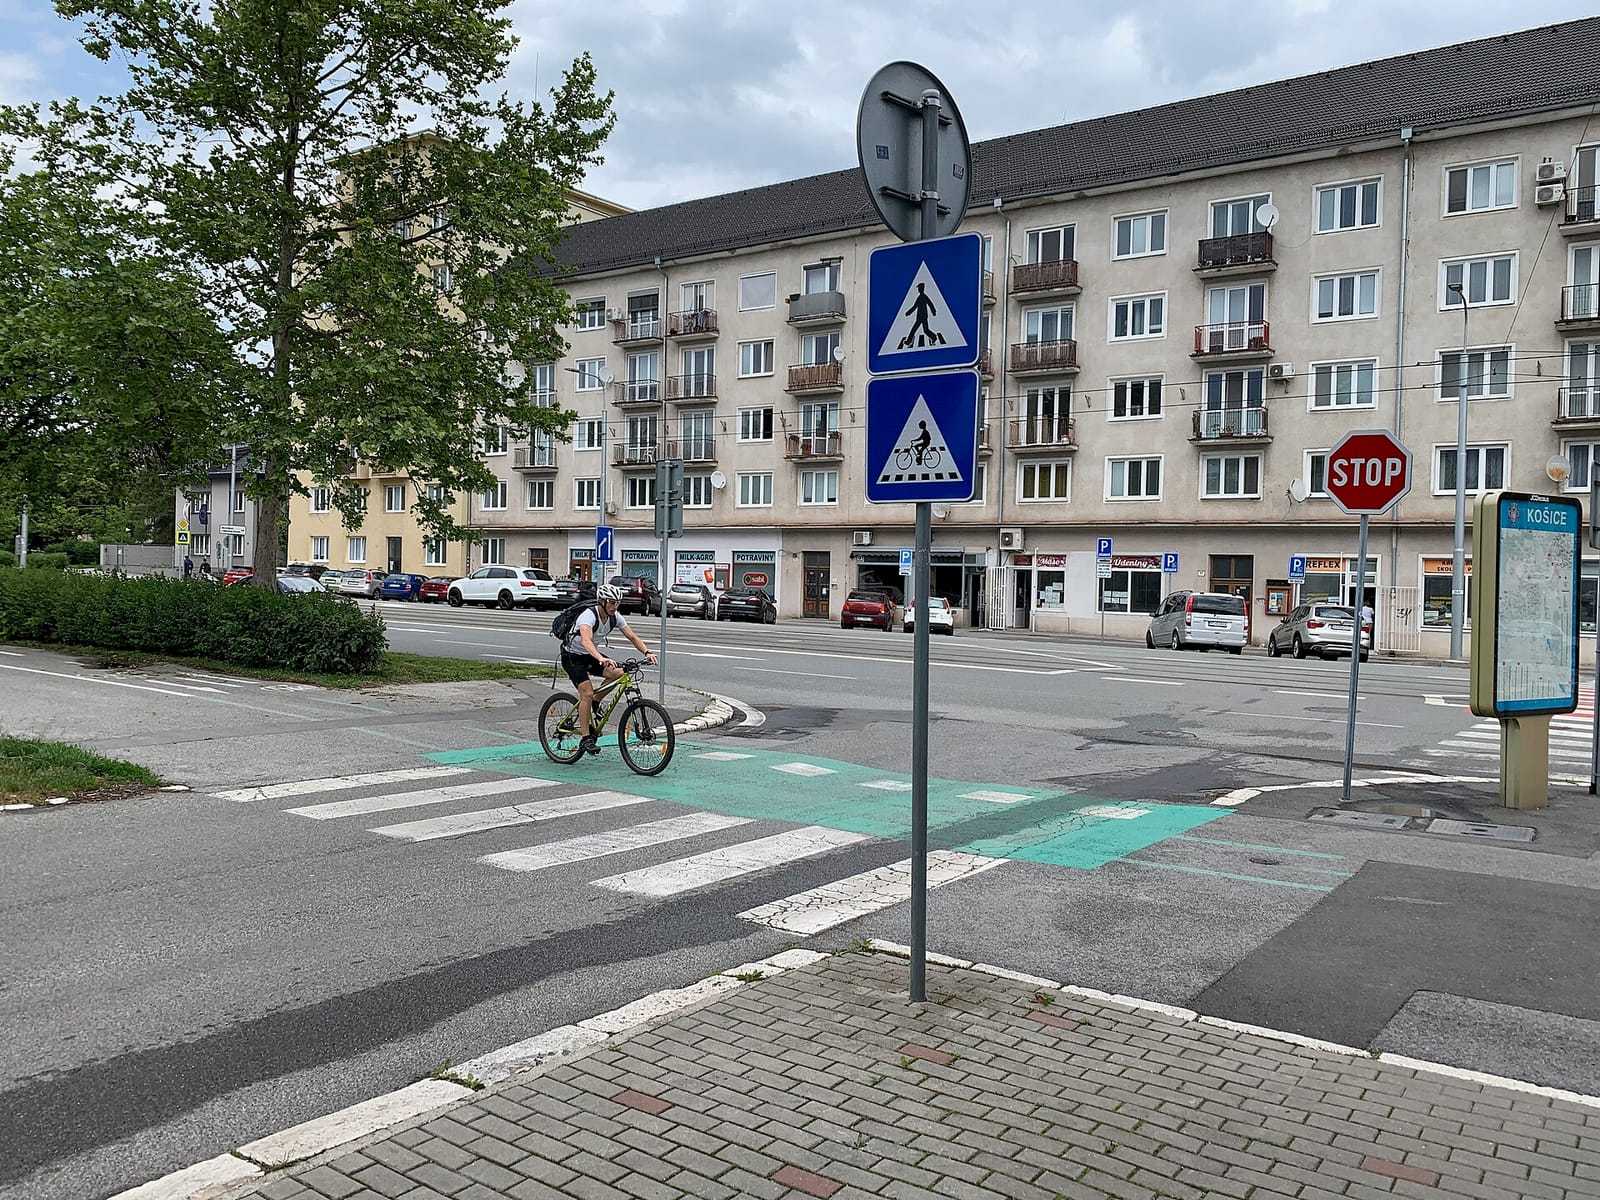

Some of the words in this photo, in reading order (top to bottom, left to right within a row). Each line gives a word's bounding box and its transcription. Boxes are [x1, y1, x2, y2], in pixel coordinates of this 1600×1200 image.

[1333, 457, 1402, 487] STOP
[1527, 506, 1567, 525] KOŠICE
[1101, 540, 1109, 552] P
[624, 552, 659, 560] POTRAVINY
[679, 553, 714, 561] MILK-AGRO
[902, 551, 910, 562] P
[1167, 554, 1175, 567] P
[1293, 559, 1302, 571] P
[1305, 560, 1341, 569] REFLEX
